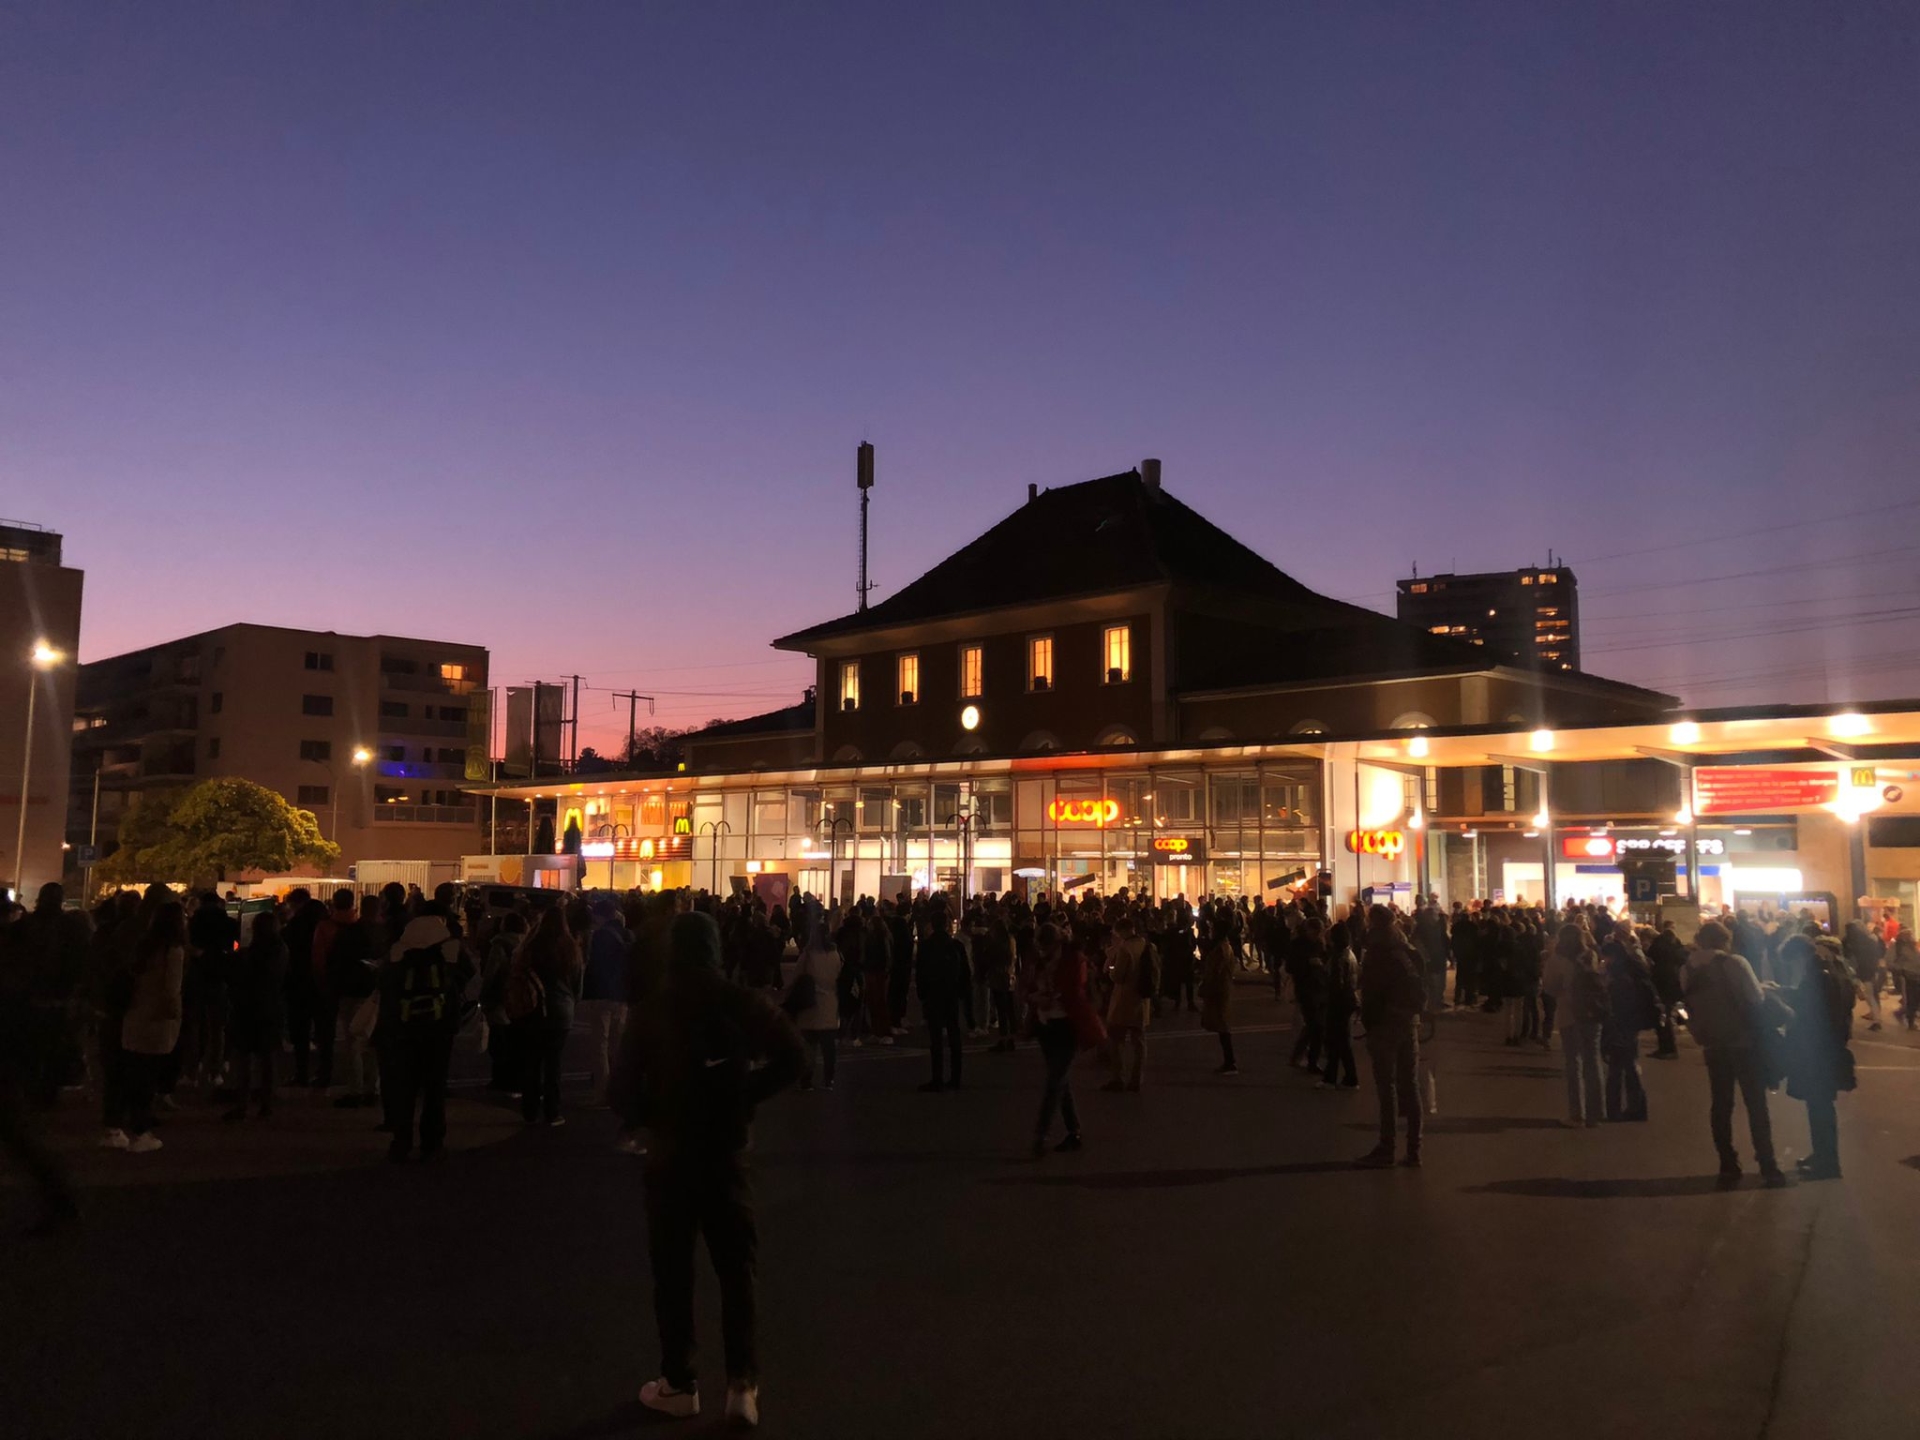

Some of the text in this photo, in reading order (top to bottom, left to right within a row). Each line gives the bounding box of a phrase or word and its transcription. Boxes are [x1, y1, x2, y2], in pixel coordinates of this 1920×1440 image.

[1049, 800, 1119, 828] coop
[1154, 838, 1188, 852] coop
[1169, 853, 1192, 862] pronto
[1636, 880, 1650, 898] P
